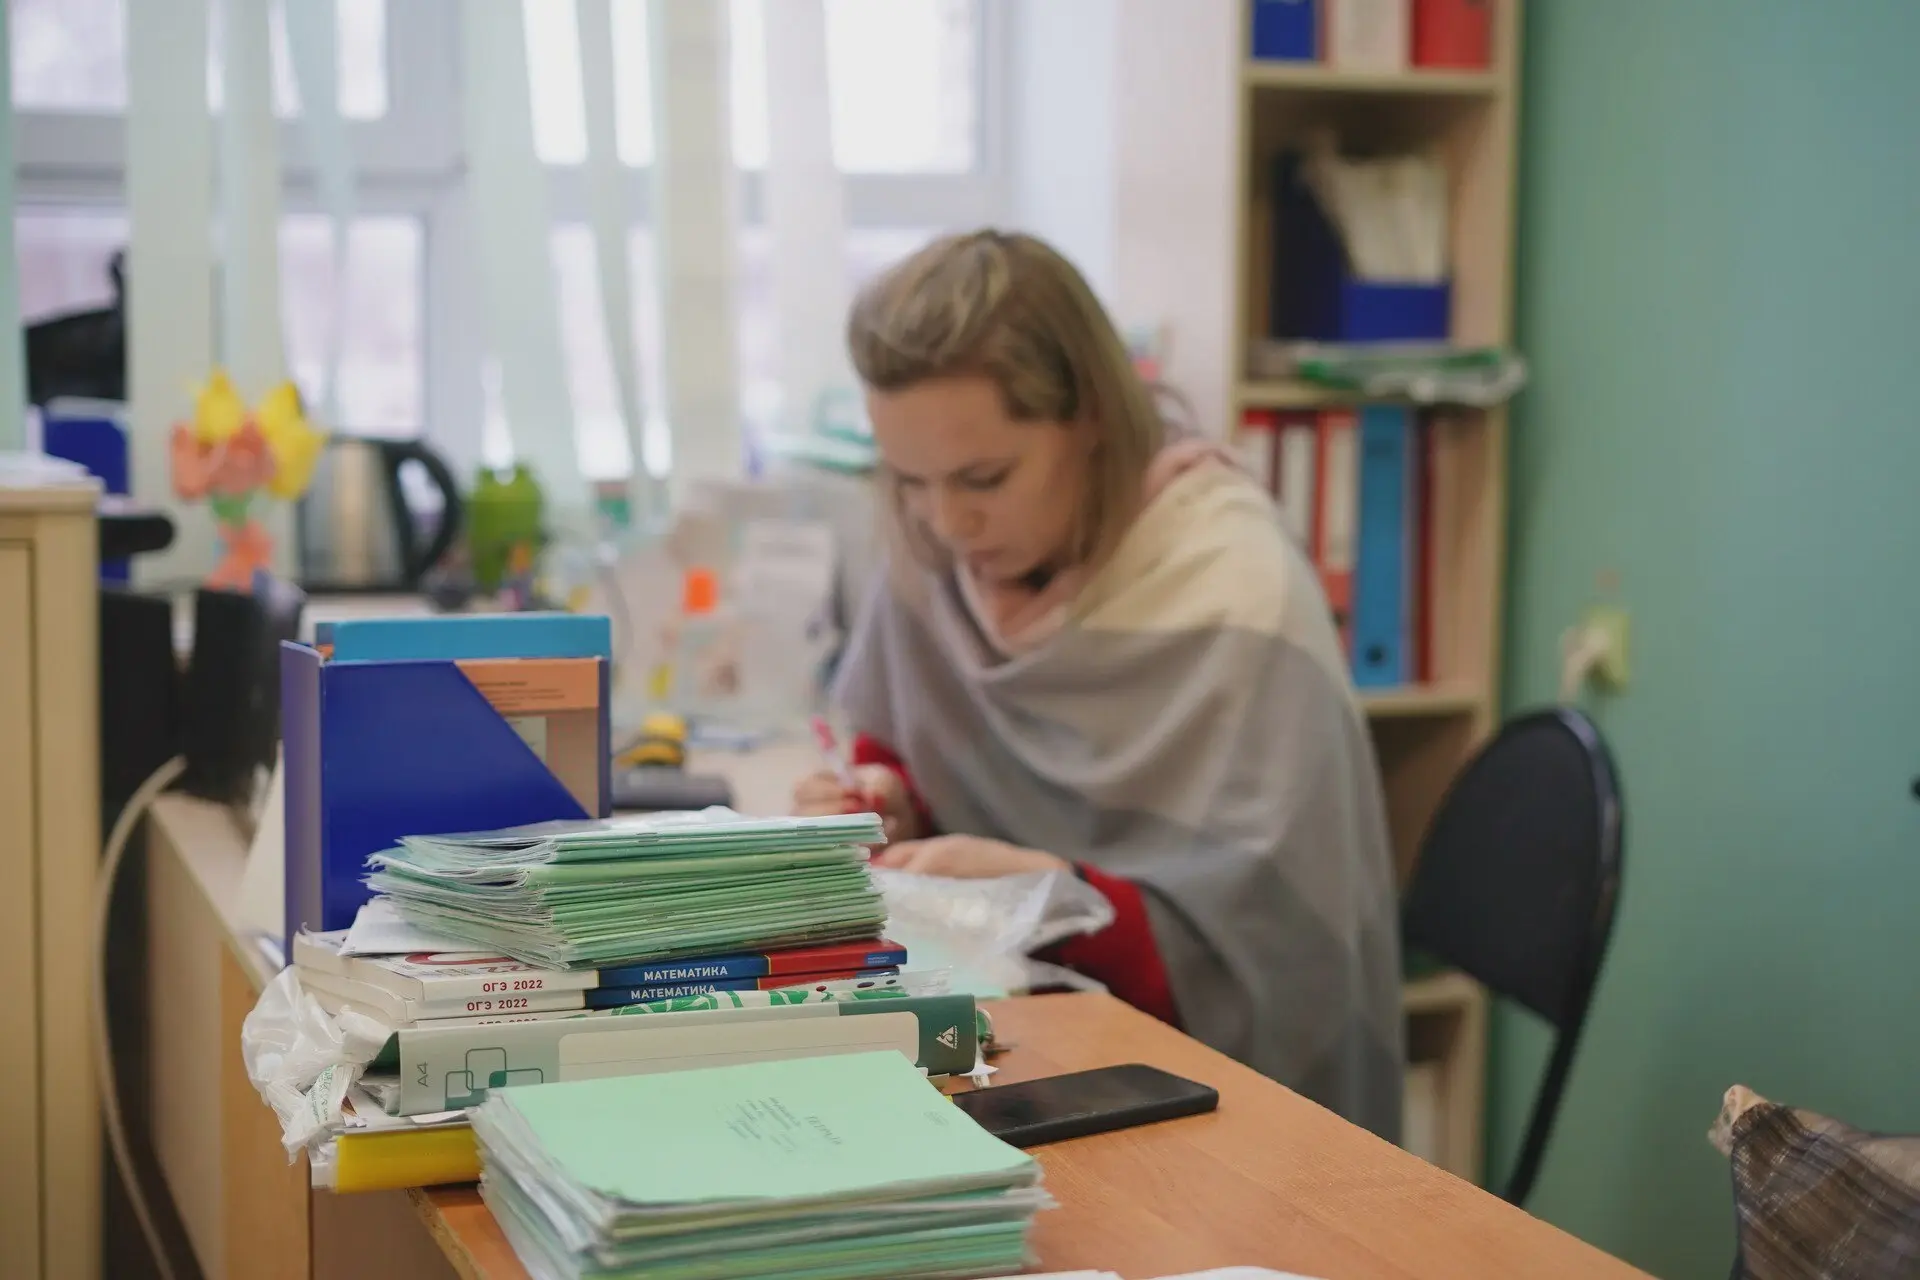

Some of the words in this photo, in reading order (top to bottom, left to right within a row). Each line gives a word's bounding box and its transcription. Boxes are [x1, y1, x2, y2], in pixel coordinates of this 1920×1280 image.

[644, 965, 728, 981] МАТЕМАТИКА
[482, 981, 508, 993] ОГЭ
[513, 979, 543, 991] 2022
[630, 984, 716, 1000] МАТЕМАТИКА
[466, 1001, 492, 1012] ОГЭ
[498, 998, 528, 1009] 2022
[416, 1061, 429, 1088] A4
